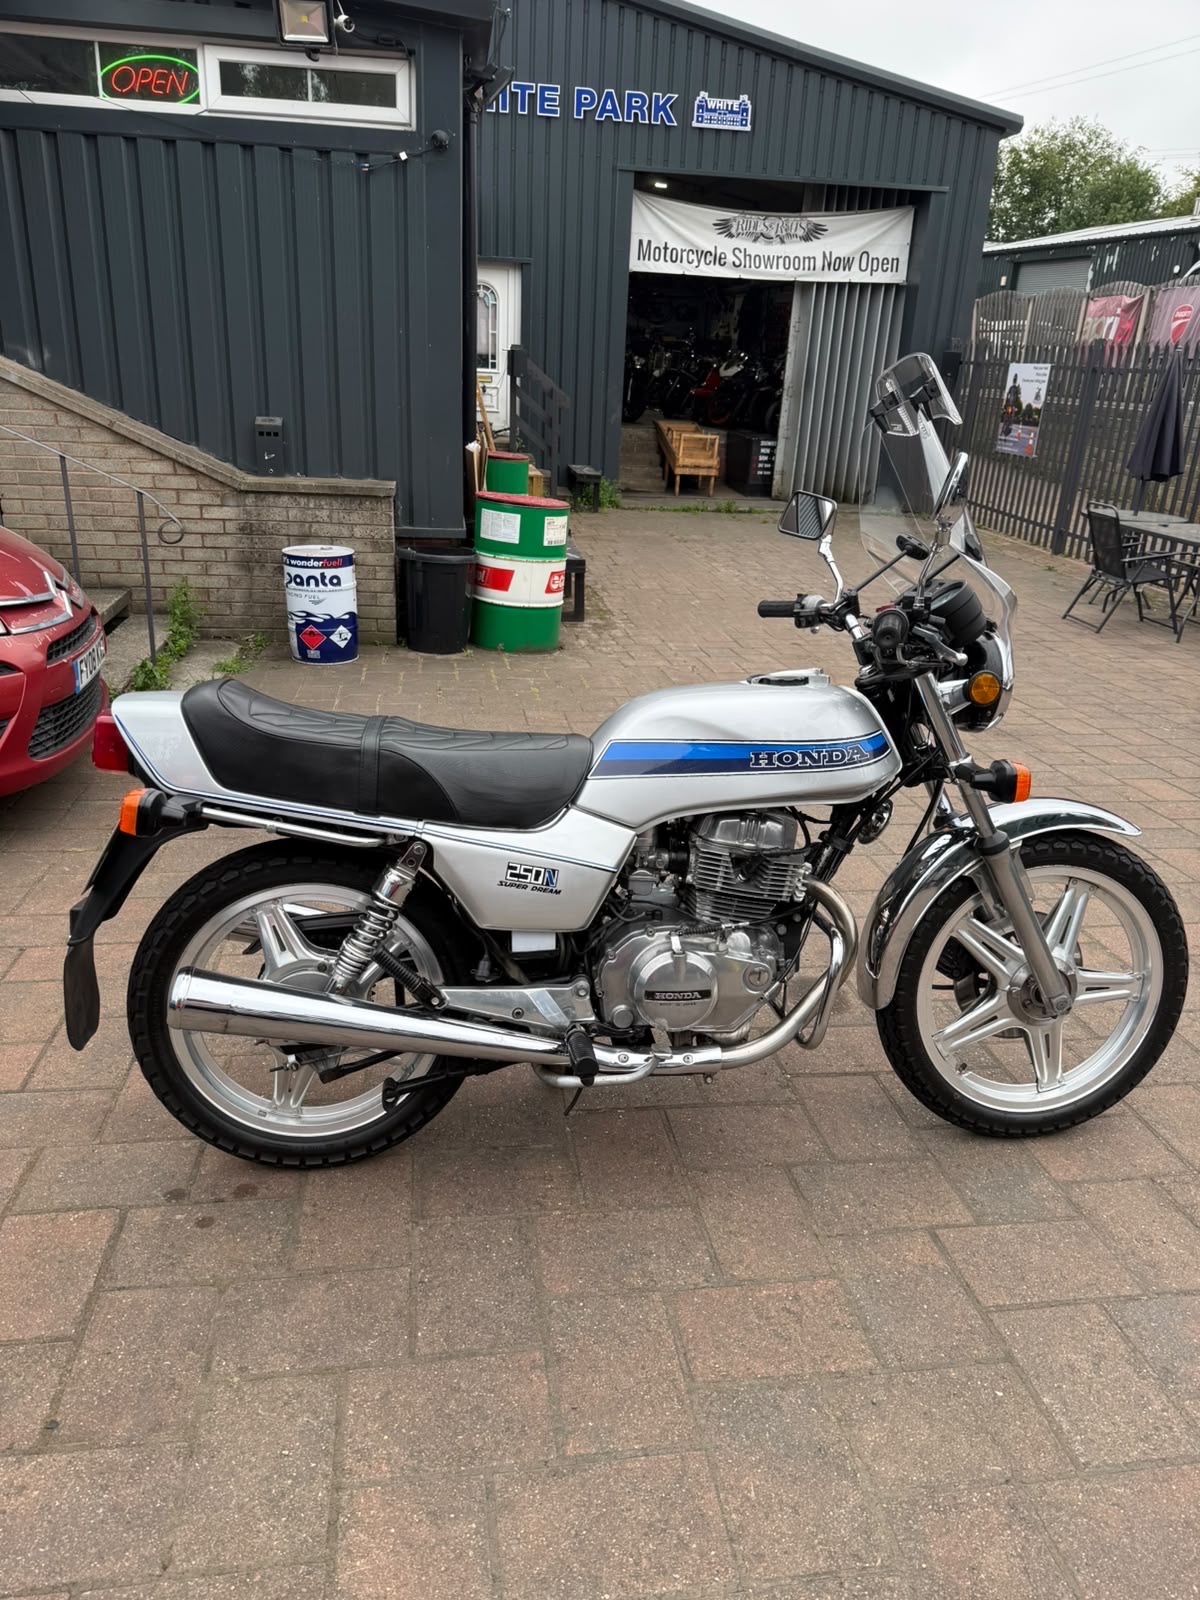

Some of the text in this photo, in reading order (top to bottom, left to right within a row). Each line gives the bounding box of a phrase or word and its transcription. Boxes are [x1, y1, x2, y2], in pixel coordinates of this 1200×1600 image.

[111, 66, 189, 96] OPEN
[486, 81, 680, 126] ITE PARK
[707, 99, 740, 111] WHITE
[637, 239, 900, 276] Motorcycle Showroom Now Open
[750, 744, 870, 768] HONDA
[497, 880, 562, 895] SUPER DREAM
[505, 862, 559, 888] 250N
[655, 991, 702, 1000] HONDA
